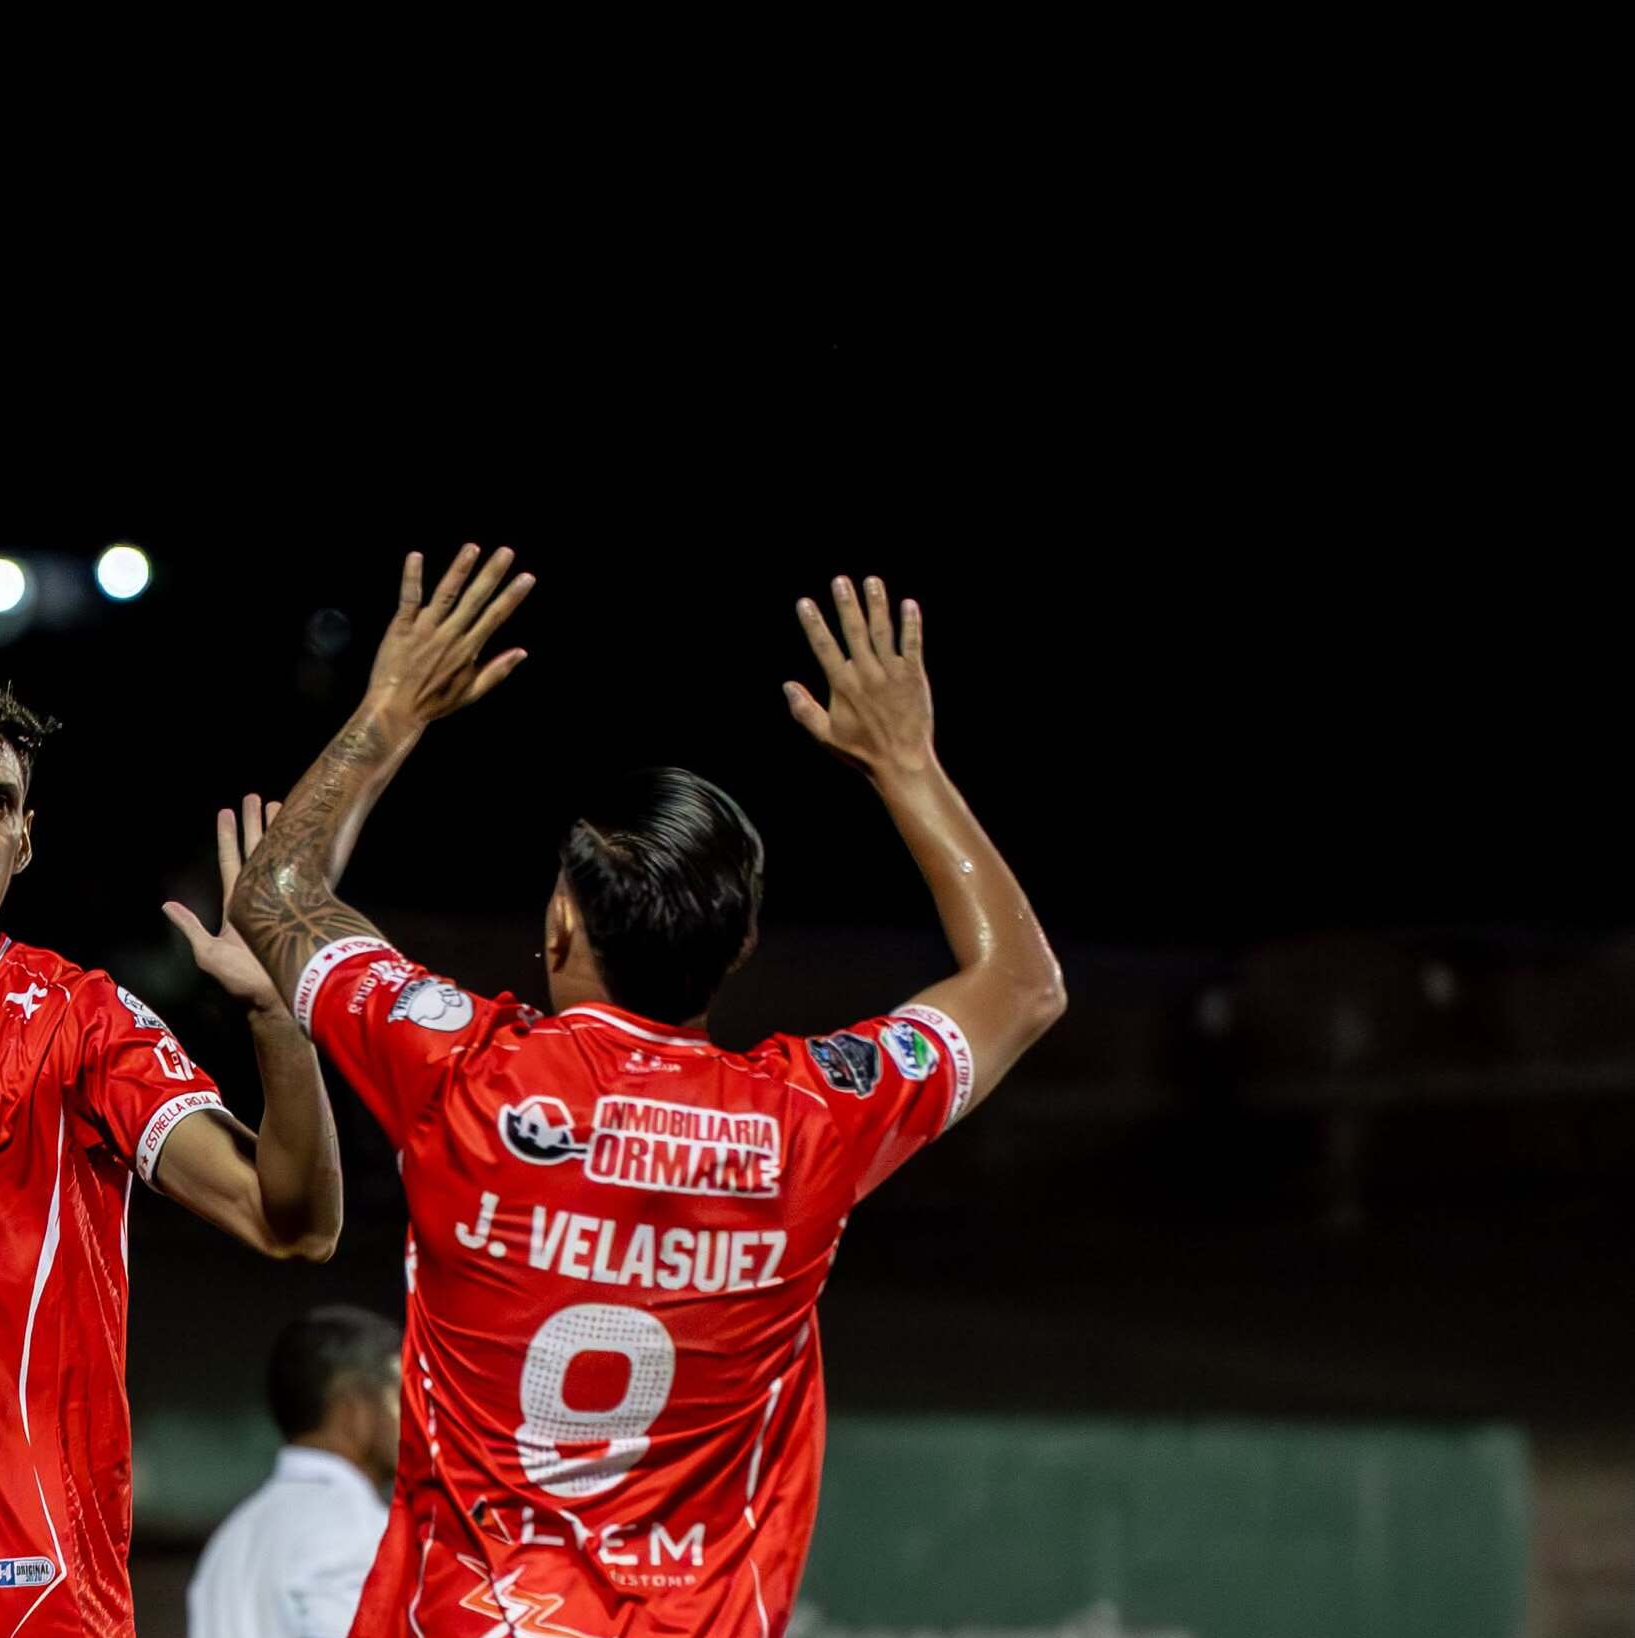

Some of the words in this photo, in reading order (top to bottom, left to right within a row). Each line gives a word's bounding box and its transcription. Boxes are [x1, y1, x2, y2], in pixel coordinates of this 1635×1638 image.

[145, 1103, 185, 1152] ESTRELLA
[184, 1097, 211, 1108] ROJA
[600, 1101, 773, 1150] INMOBILIARIA
[455, 1191, 507, 1258] J.
[528, 1205, 787, 1293] VELASUEZ
[514, 1303, 676, 1498] 8
[16, 1564, 49, 1576] ORIGINAL
